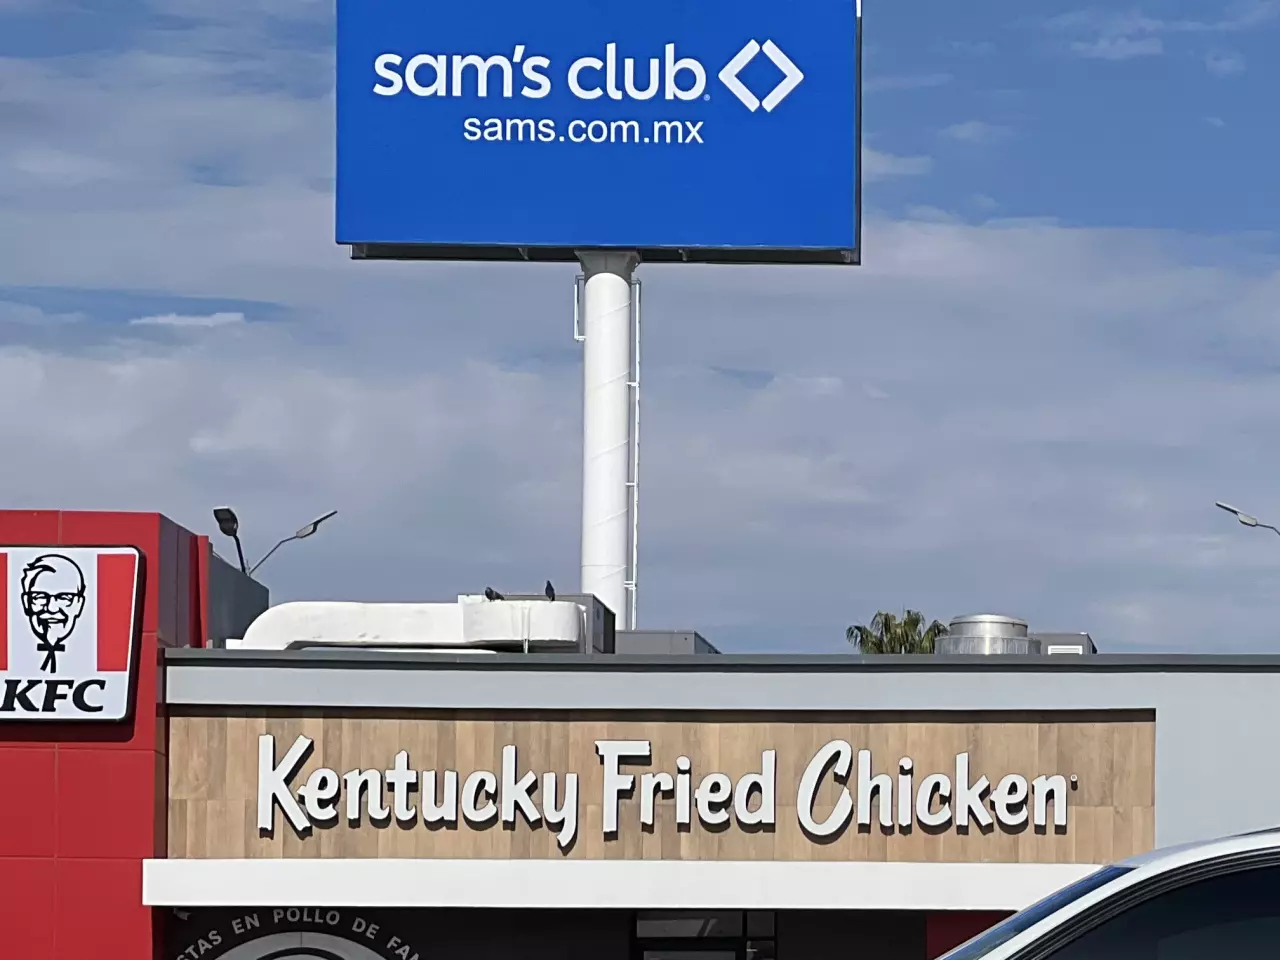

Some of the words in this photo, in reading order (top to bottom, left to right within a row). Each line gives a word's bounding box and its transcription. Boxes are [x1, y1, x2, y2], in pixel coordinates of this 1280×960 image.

[567, 43, 704, 101] club
[463, 117, 704, 144] sams.com.mx
[0, 679, 107, 713] KFC
[257, 734, 577, 848] Kentucky
[594, 740, 776, 834] Fried
[798, 740, 1067, 836] Chicken
[231, 913, 260, 935] EN
[273, 908, 340, 925] POLLO
[351, 917, 380, 939] DE
